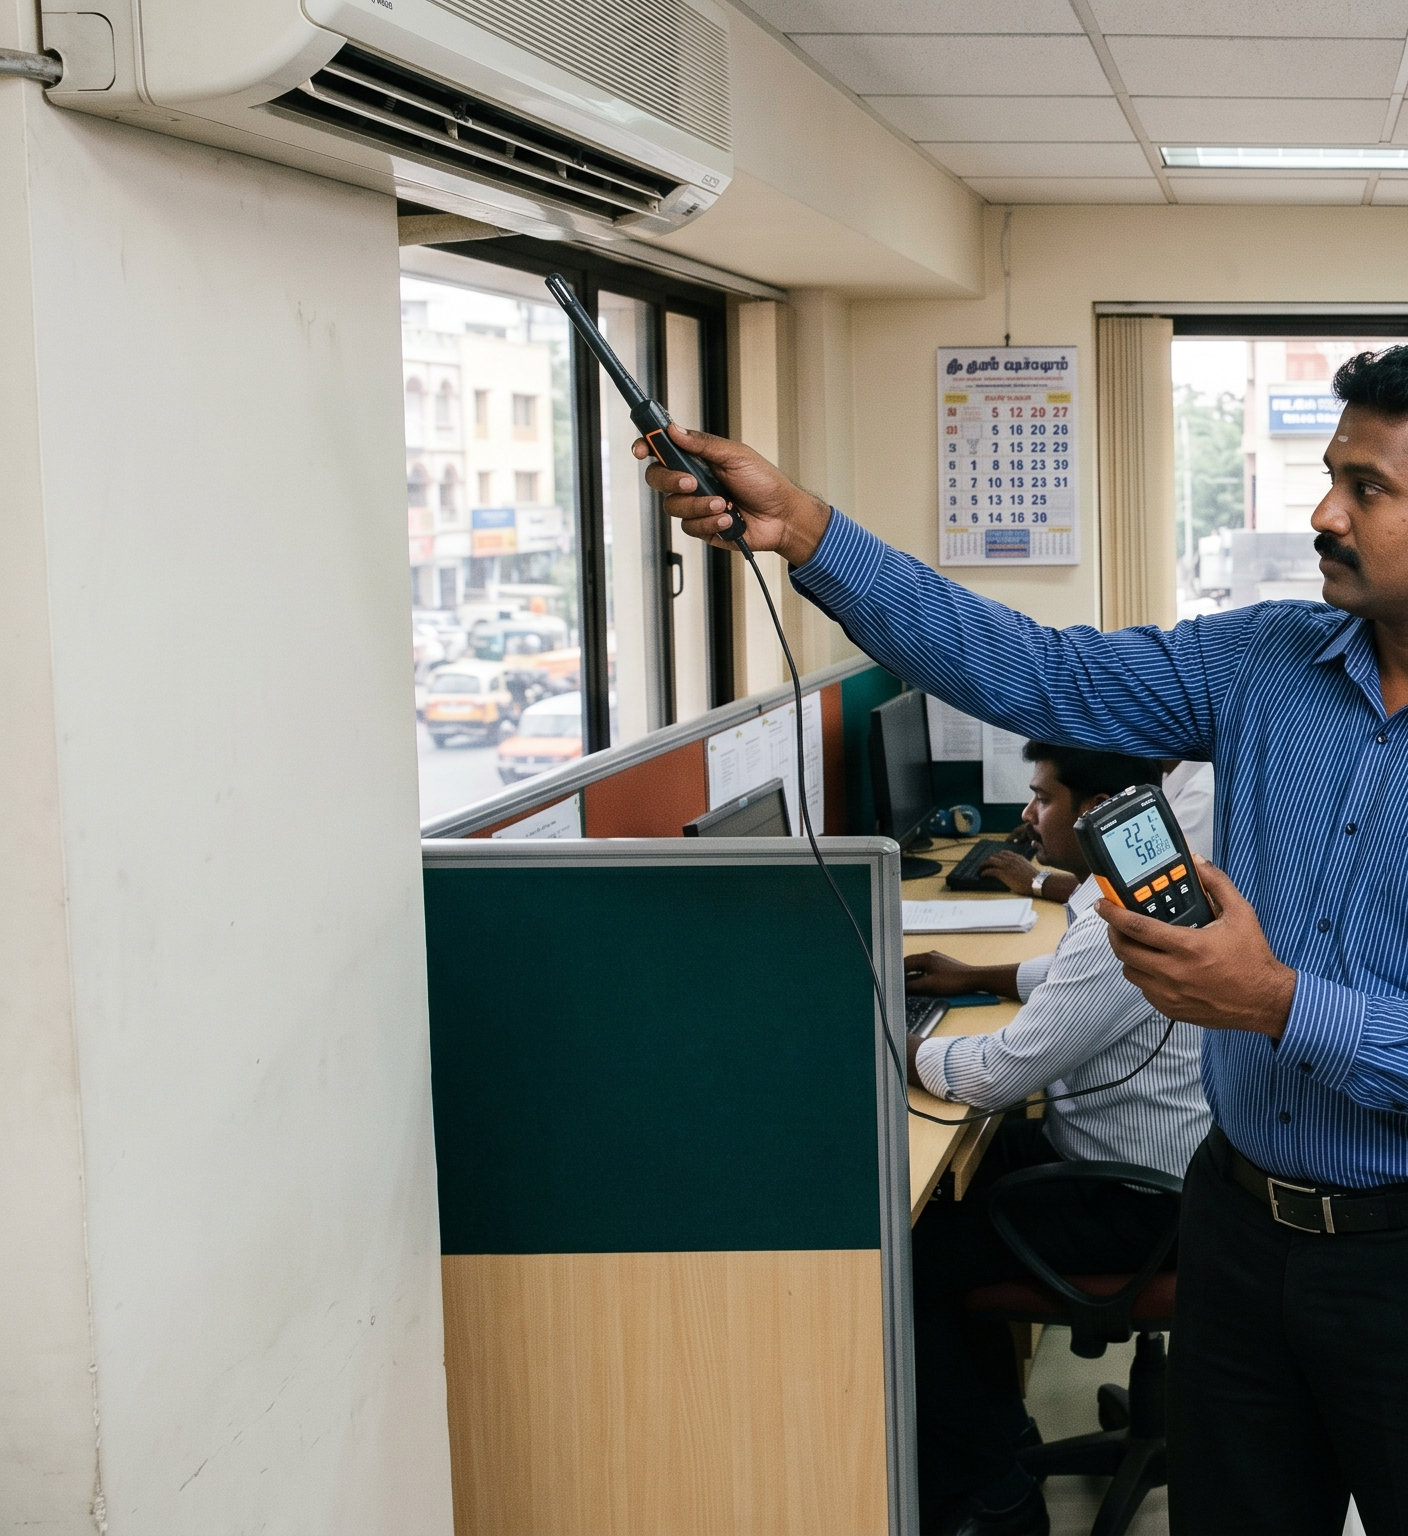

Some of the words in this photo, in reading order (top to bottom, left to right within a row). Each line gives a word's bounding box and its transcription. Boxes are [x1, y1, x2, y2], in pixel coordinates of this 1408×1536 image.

[1009, 407, 1023, 417] 12
[1053, 407, 1068, 417] 27
[1031, 424, 1046, 435] 20
[1053, 424, 1068, 435] 26
[1009, 442, 1023, 452] 15
[1031, 442, 1046, 452] 22
[1053, 442, 1068, 452] 29
[970, 460, 977, 470] 1
[992, 460, 1000, 470] 8
[1009, 460, 1023, 470] 18
[1031, 460, 1046, 470] 23
[1054, 460, 1068, 470] 39
[971, 478, 977, 488] 7
[988, 478, 1002, 488] 10
[1010, 477, 1024, 488] 13
[1031, 477, 1047, 488] 23
[1054, 477, 1068, 487] 31
[971, 495, 978, 505] 5
[988, 495, 1002, 505] 13
[1031, 495, 1047, 505] 25
[949, 513, 957, 523] 4
[988, 513, 1002, 523] 14
